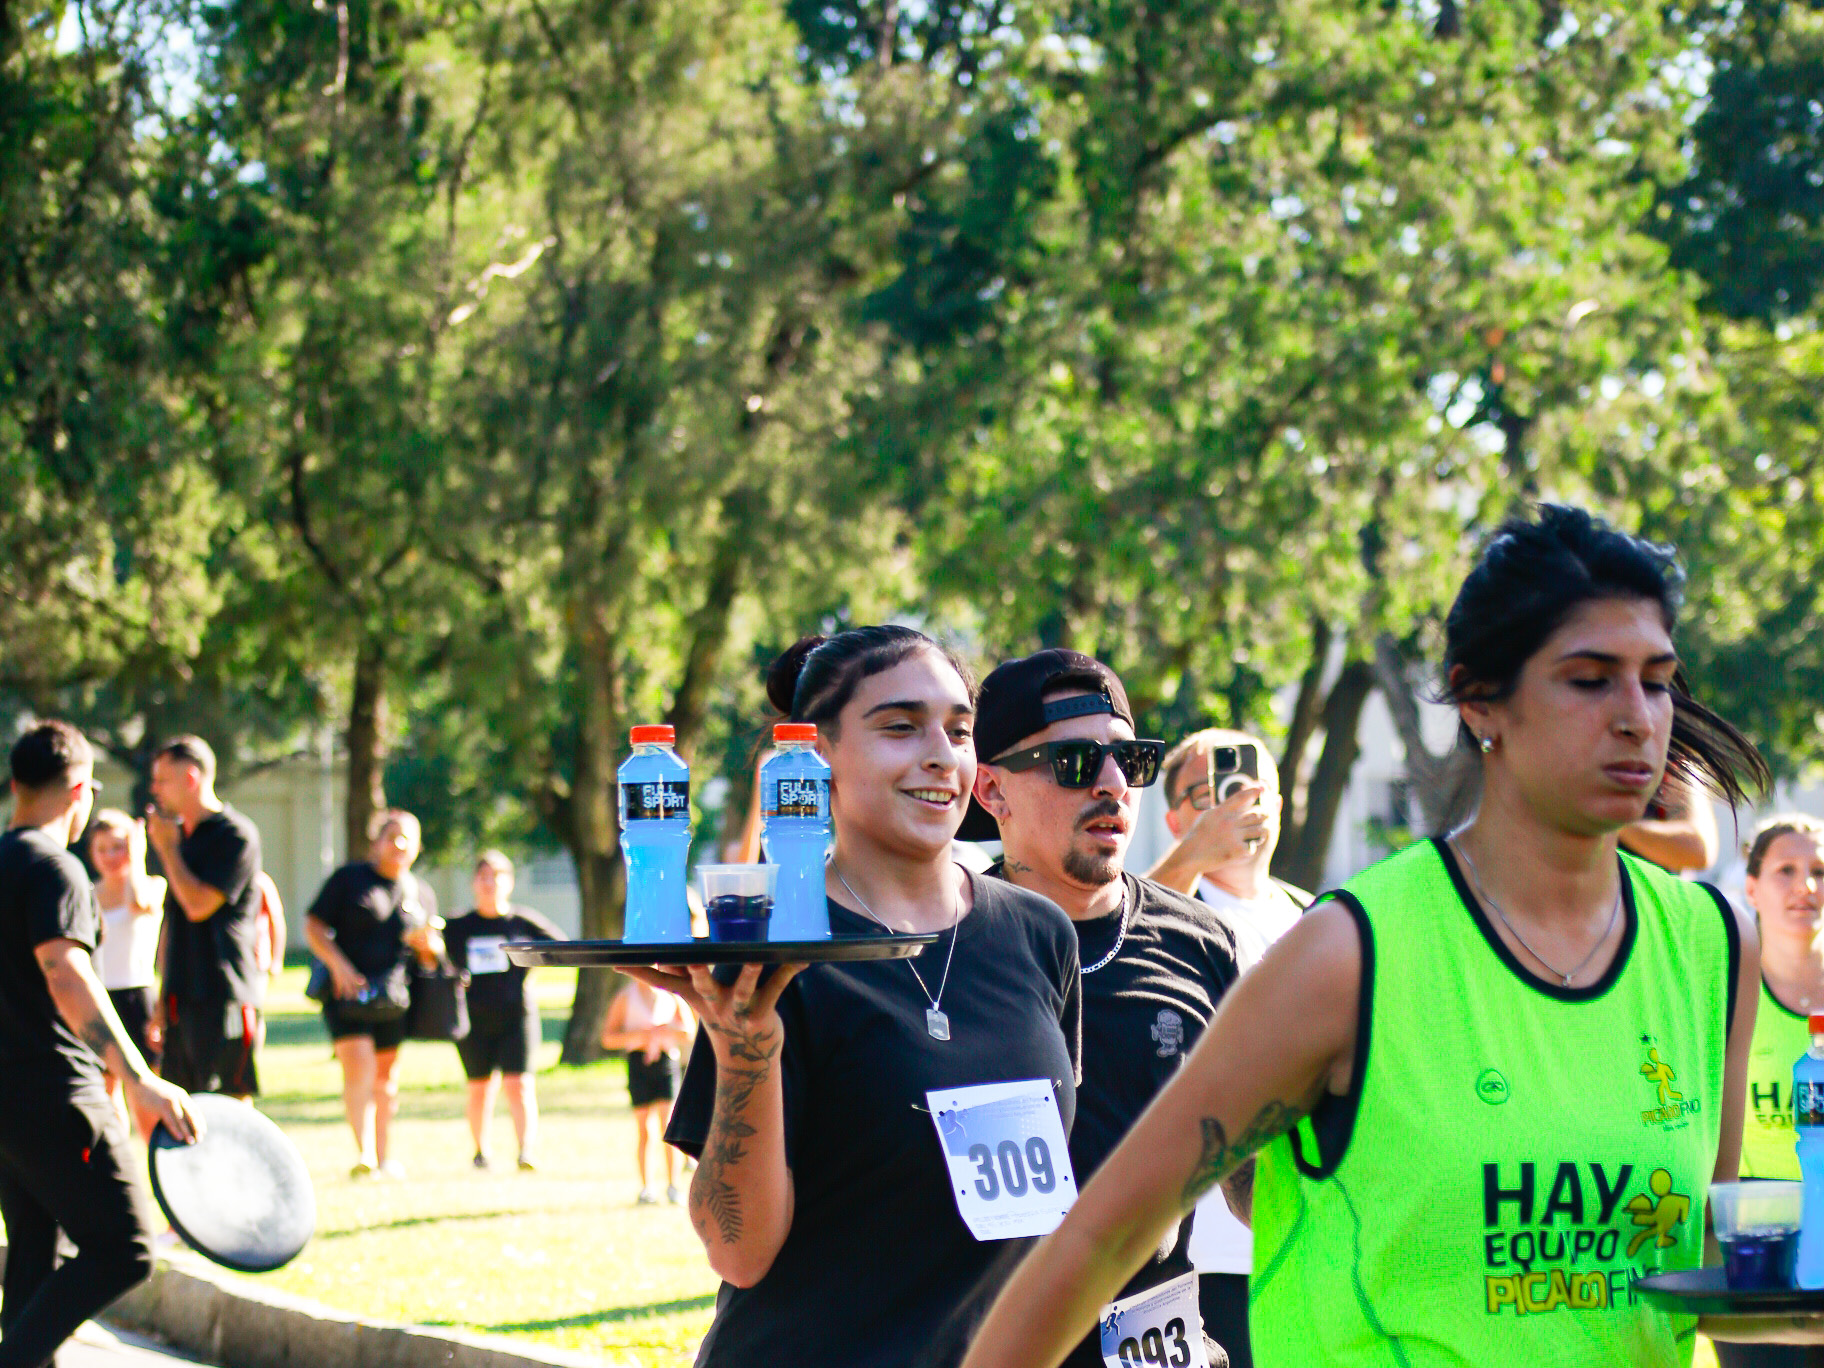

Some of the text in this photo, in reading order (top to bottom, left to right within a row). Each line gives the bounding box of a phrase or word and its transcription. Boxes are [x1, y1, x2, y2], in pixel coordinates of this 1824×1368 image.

[643, 785, 676, 796] FULL
[780, 782, 814, 794] FULL
[643, 795, 685, 808] SPORT
[780, 793, 823, 805] SPORT
[967, 1136, 1056, 1201] 309
[1481, 1162, 1634, 1228] HAY
